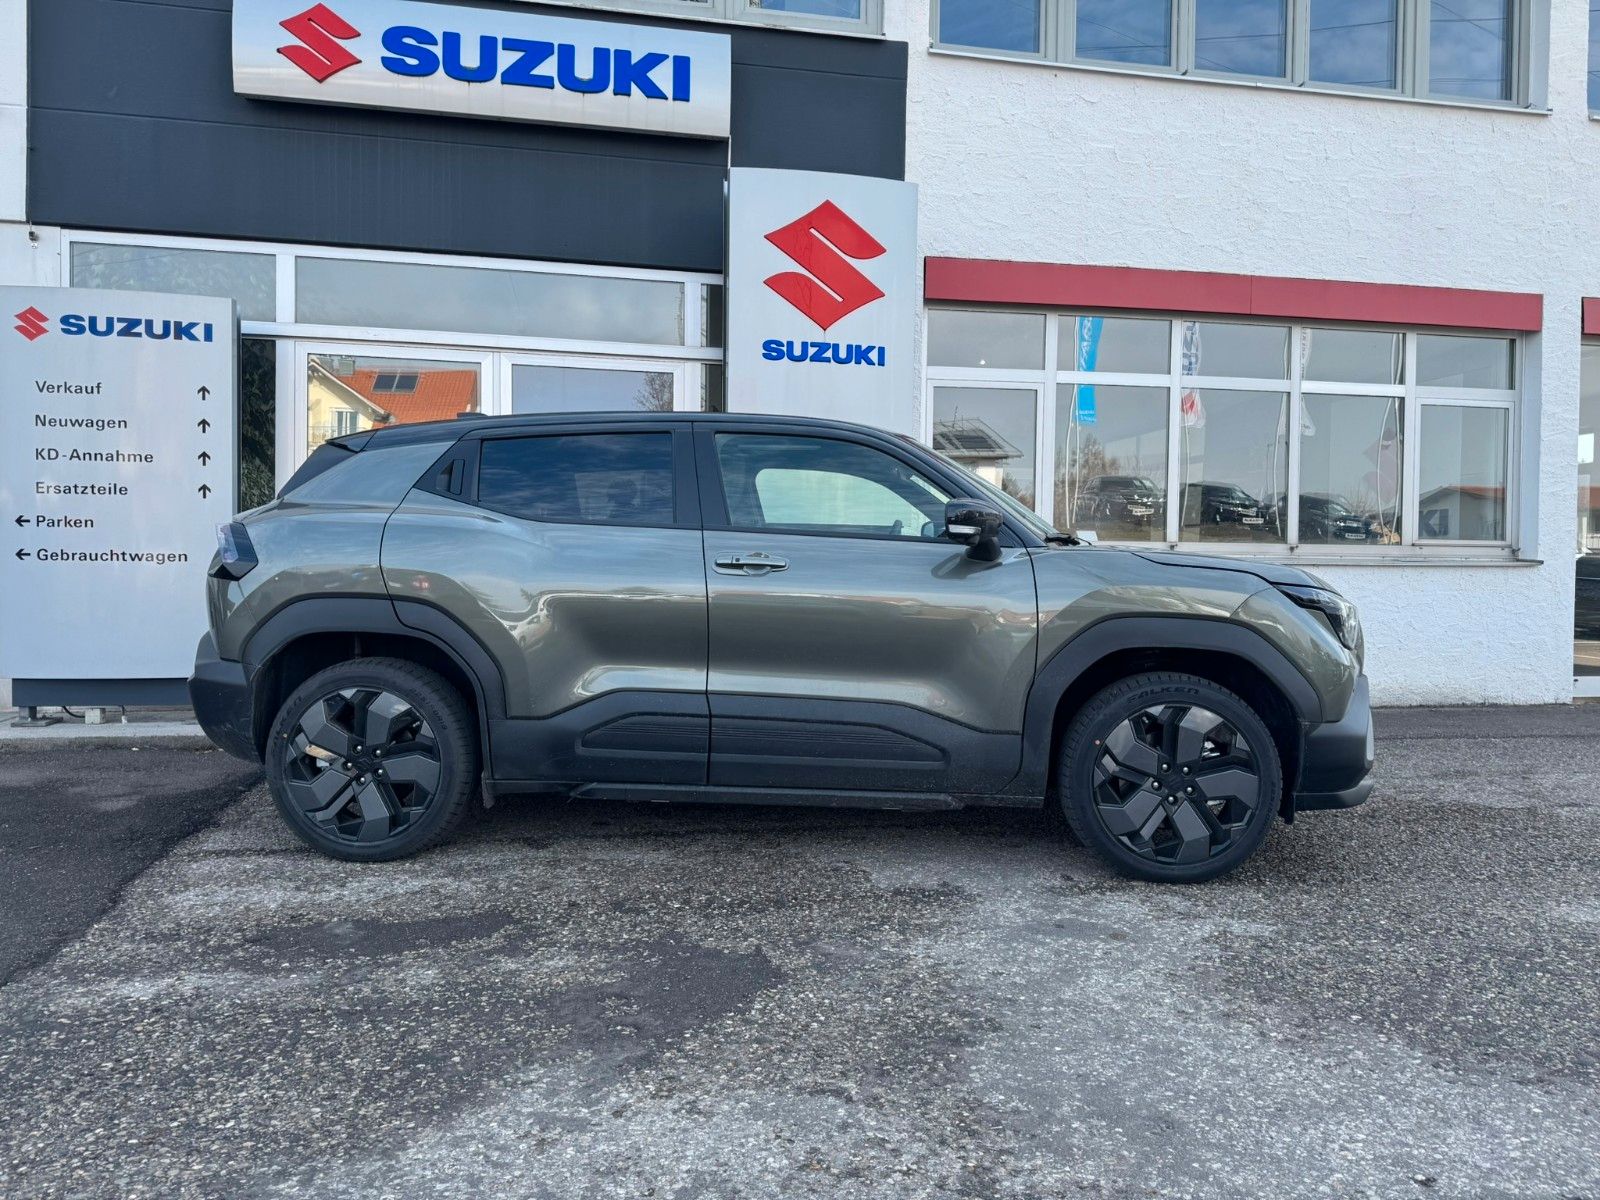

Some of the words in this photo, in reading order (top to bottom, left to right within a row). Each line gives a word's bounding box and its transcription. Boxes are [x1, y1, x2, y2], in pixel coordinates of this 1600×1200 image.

[380, 25, 691, 102] SUZUKI
[59, 314, 213, 343] SUZUKI
[762, 339, 886, 367] SUZUKI
[35, 380, 103, 395] Verkauf
[35, 414, 128, 431] Neuwagen
[35, 448, 154, 464] KD-Annahme
[35, 481, 129, 497] Ersatzteile
[36, 515, 94, 529] Parken
[36, 548, 189, 565] Gebrauchtwagen
[1127, 686, 1200, 704] FALKEN
